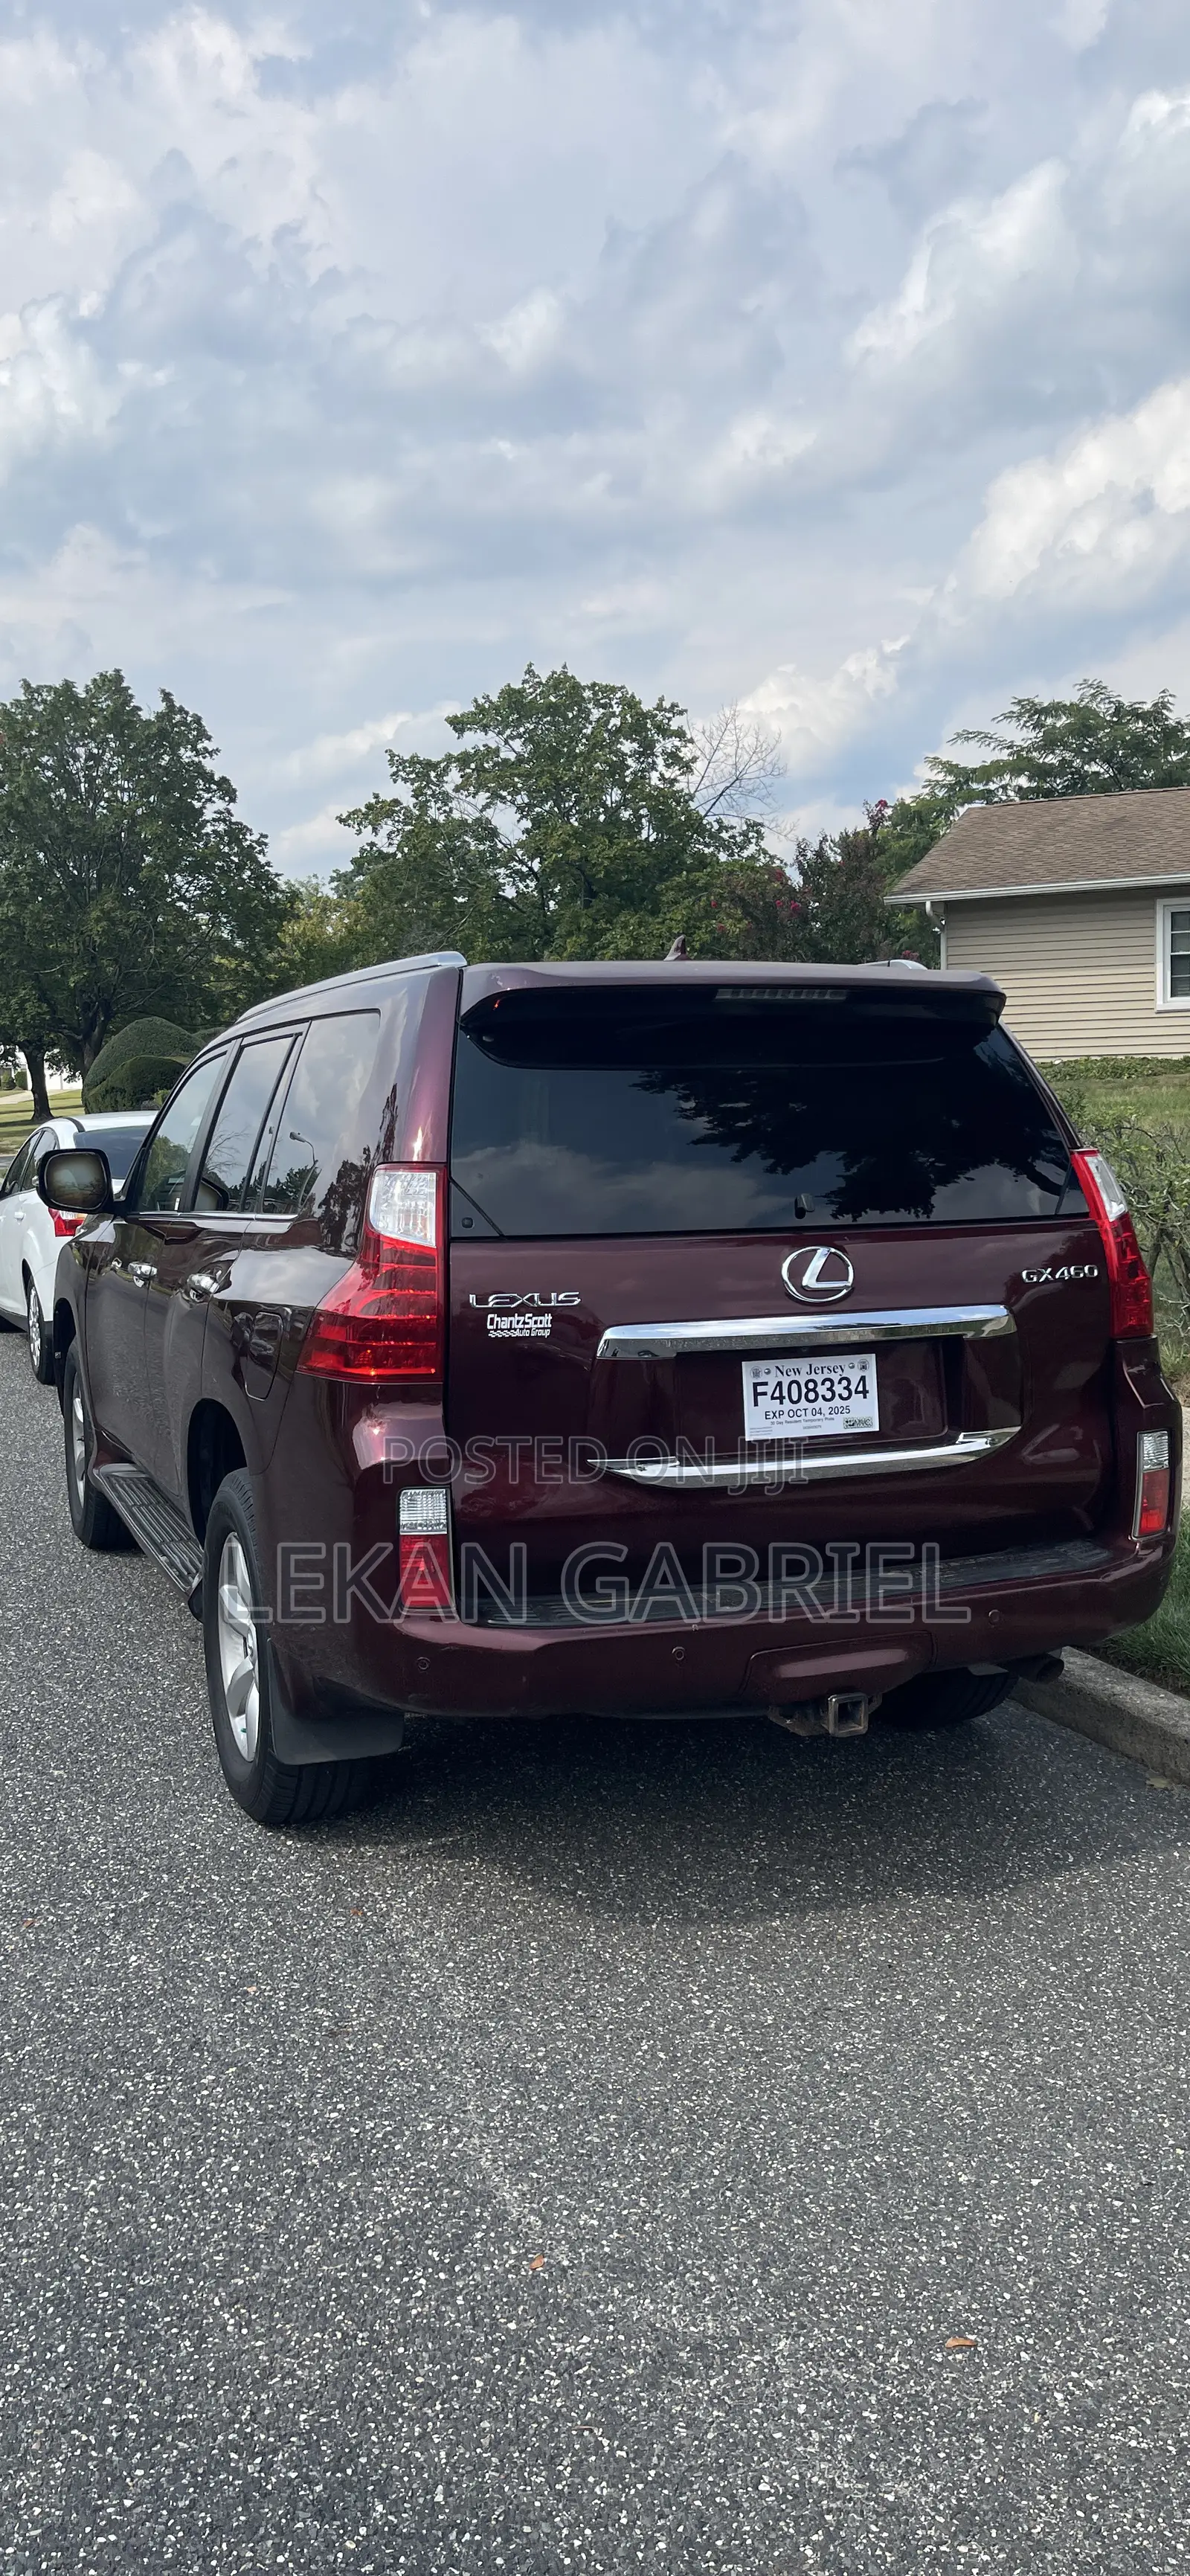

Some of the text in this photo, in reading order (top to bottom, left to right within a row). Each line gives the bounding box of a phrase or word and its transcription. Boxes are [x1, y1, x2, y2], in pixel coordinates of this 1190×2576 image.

[1021, 1265, 1099, 1283] GX460
[469, 1291, 582, 1308] LEXUS
[516, 1328, 550, 1338] Auto Group
[774, 1363, 846, 1378] New Jersey
[752, 1375, 869, 1407] F408334
[765, 1405, 851, 1420] EXP OCT 04, 2025
